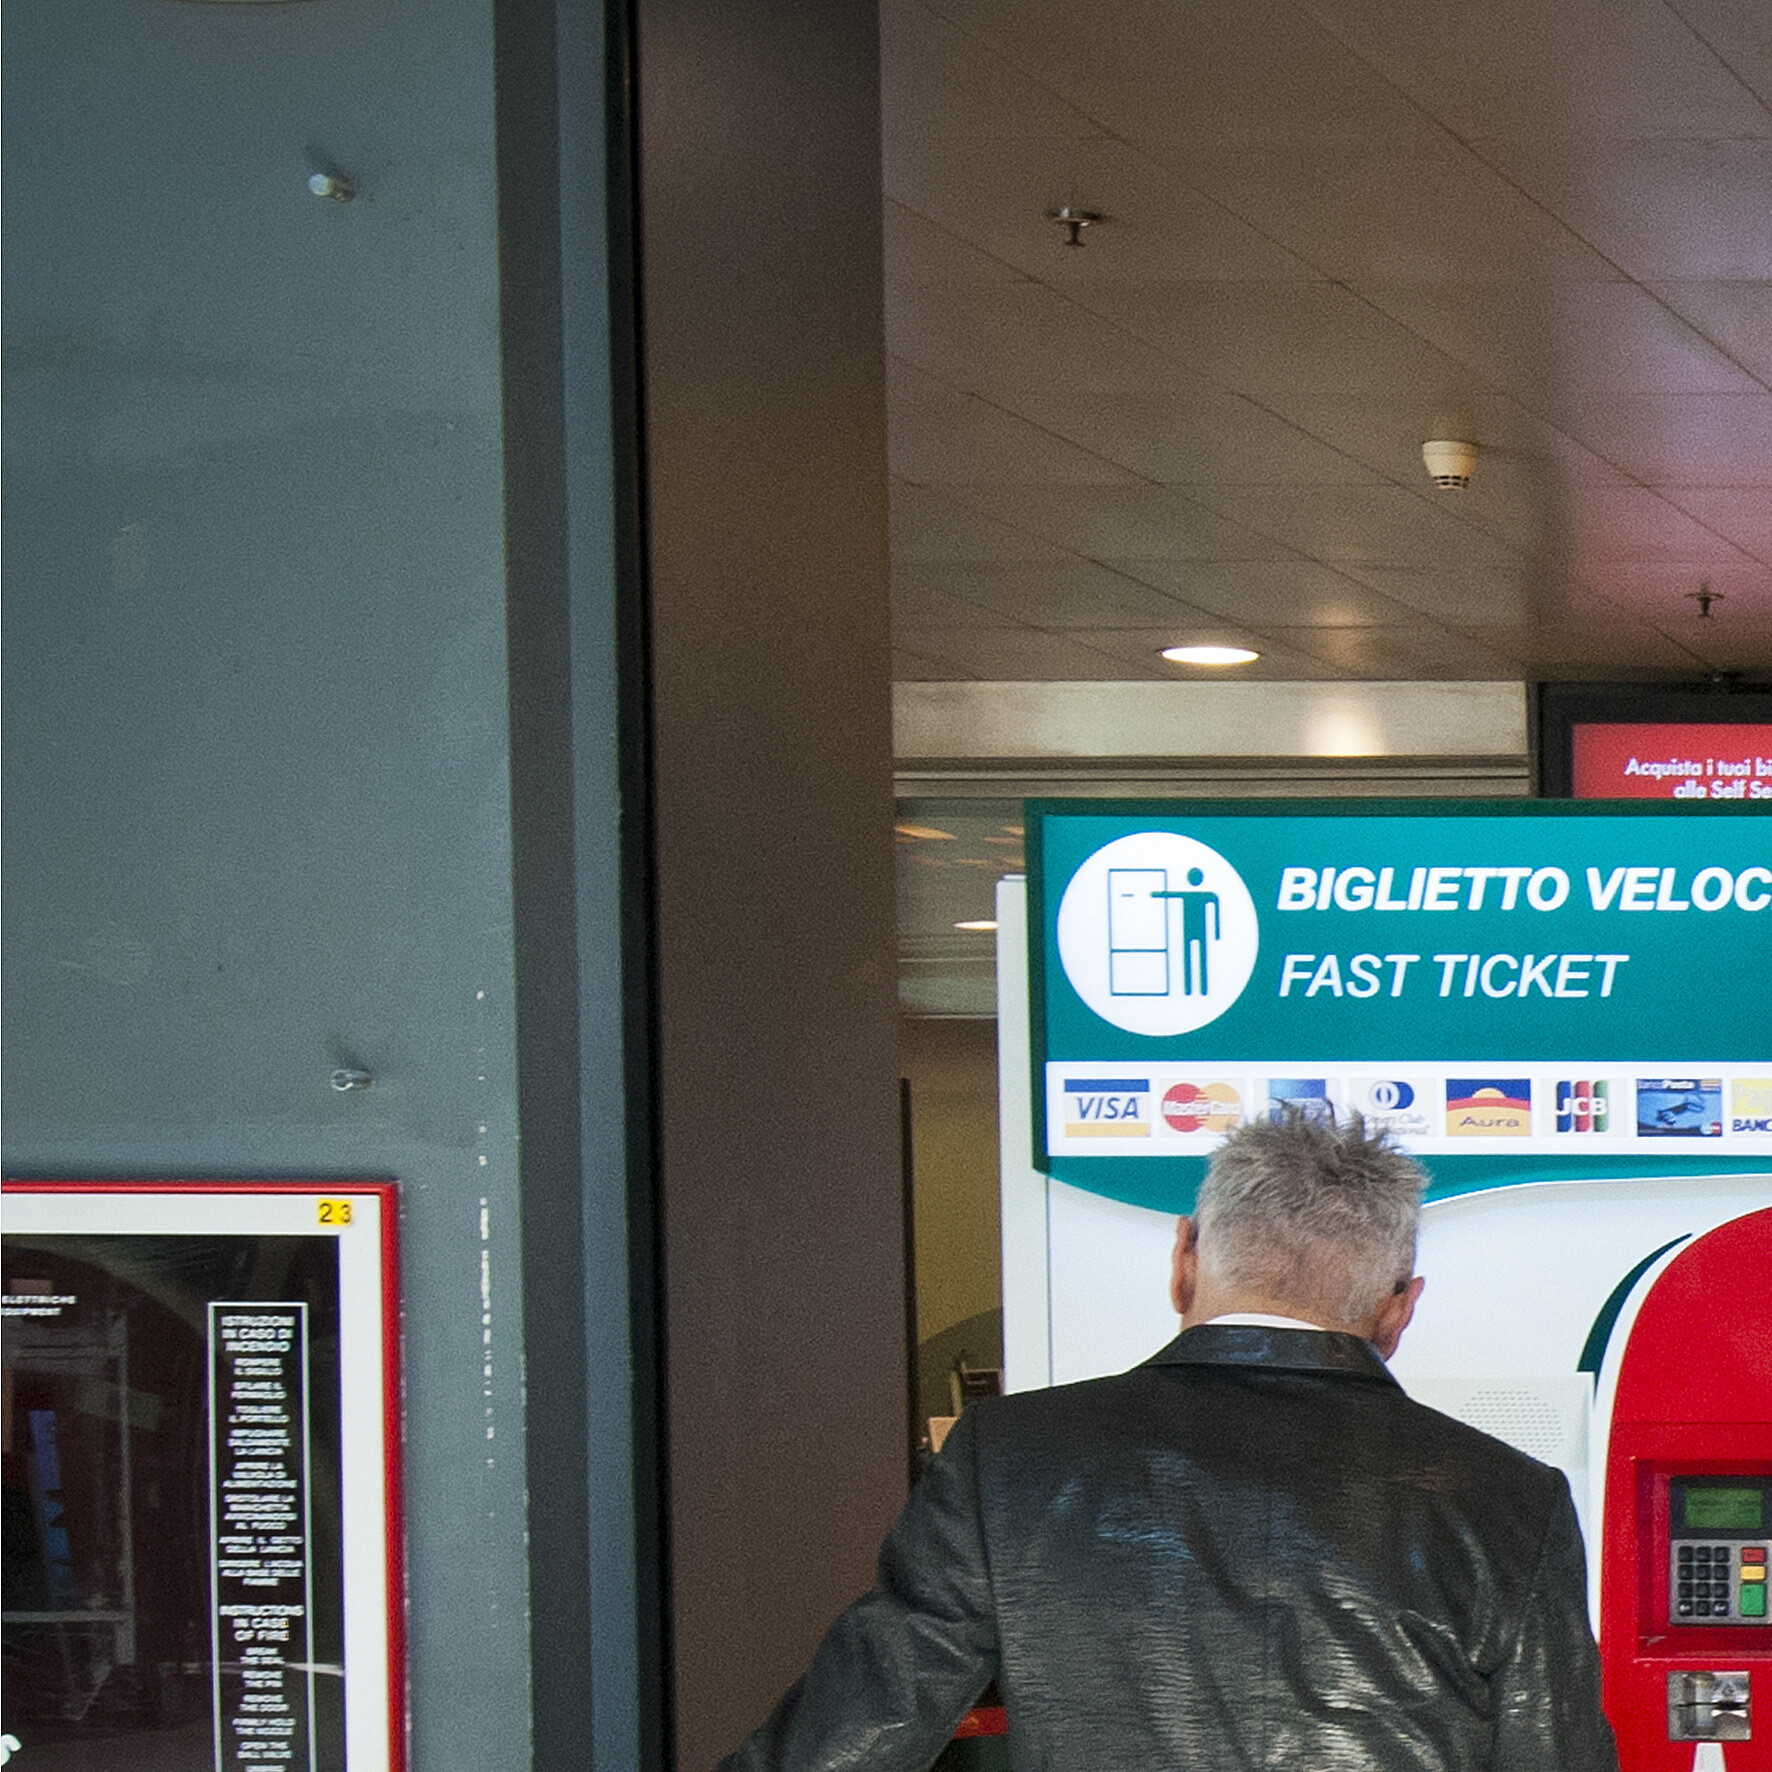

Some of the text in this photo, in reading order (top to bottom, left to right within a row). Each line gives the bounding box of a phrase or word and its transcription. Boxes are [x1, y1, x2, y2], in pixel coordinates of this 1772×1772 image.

[1624, 757, 1703, 780] Acquista
[1706, 758, 1714, 776] i
[1716, 758, 1751, 776] tuoi
[1710, 779, 1747, 799] Self
[1277, 866, 1570, 911] BIGLIETTO
[1279, 954, 1629, 998] FAST TICKET
[1077, 1097, 1139, 1119] VISA
[1163, 1101, 1241, 1115] MasterCard
[1556, 1097, 1609, 1115] JCB
[1459, 1116, 1519, 1127] Aura
[239, 1328, 276, 1339] CASO
[277, 1328, 294, 1339] DI
[251, 1618, 289, 1629] CASE
[234, 1630, 290, 1641] OF FIRE
